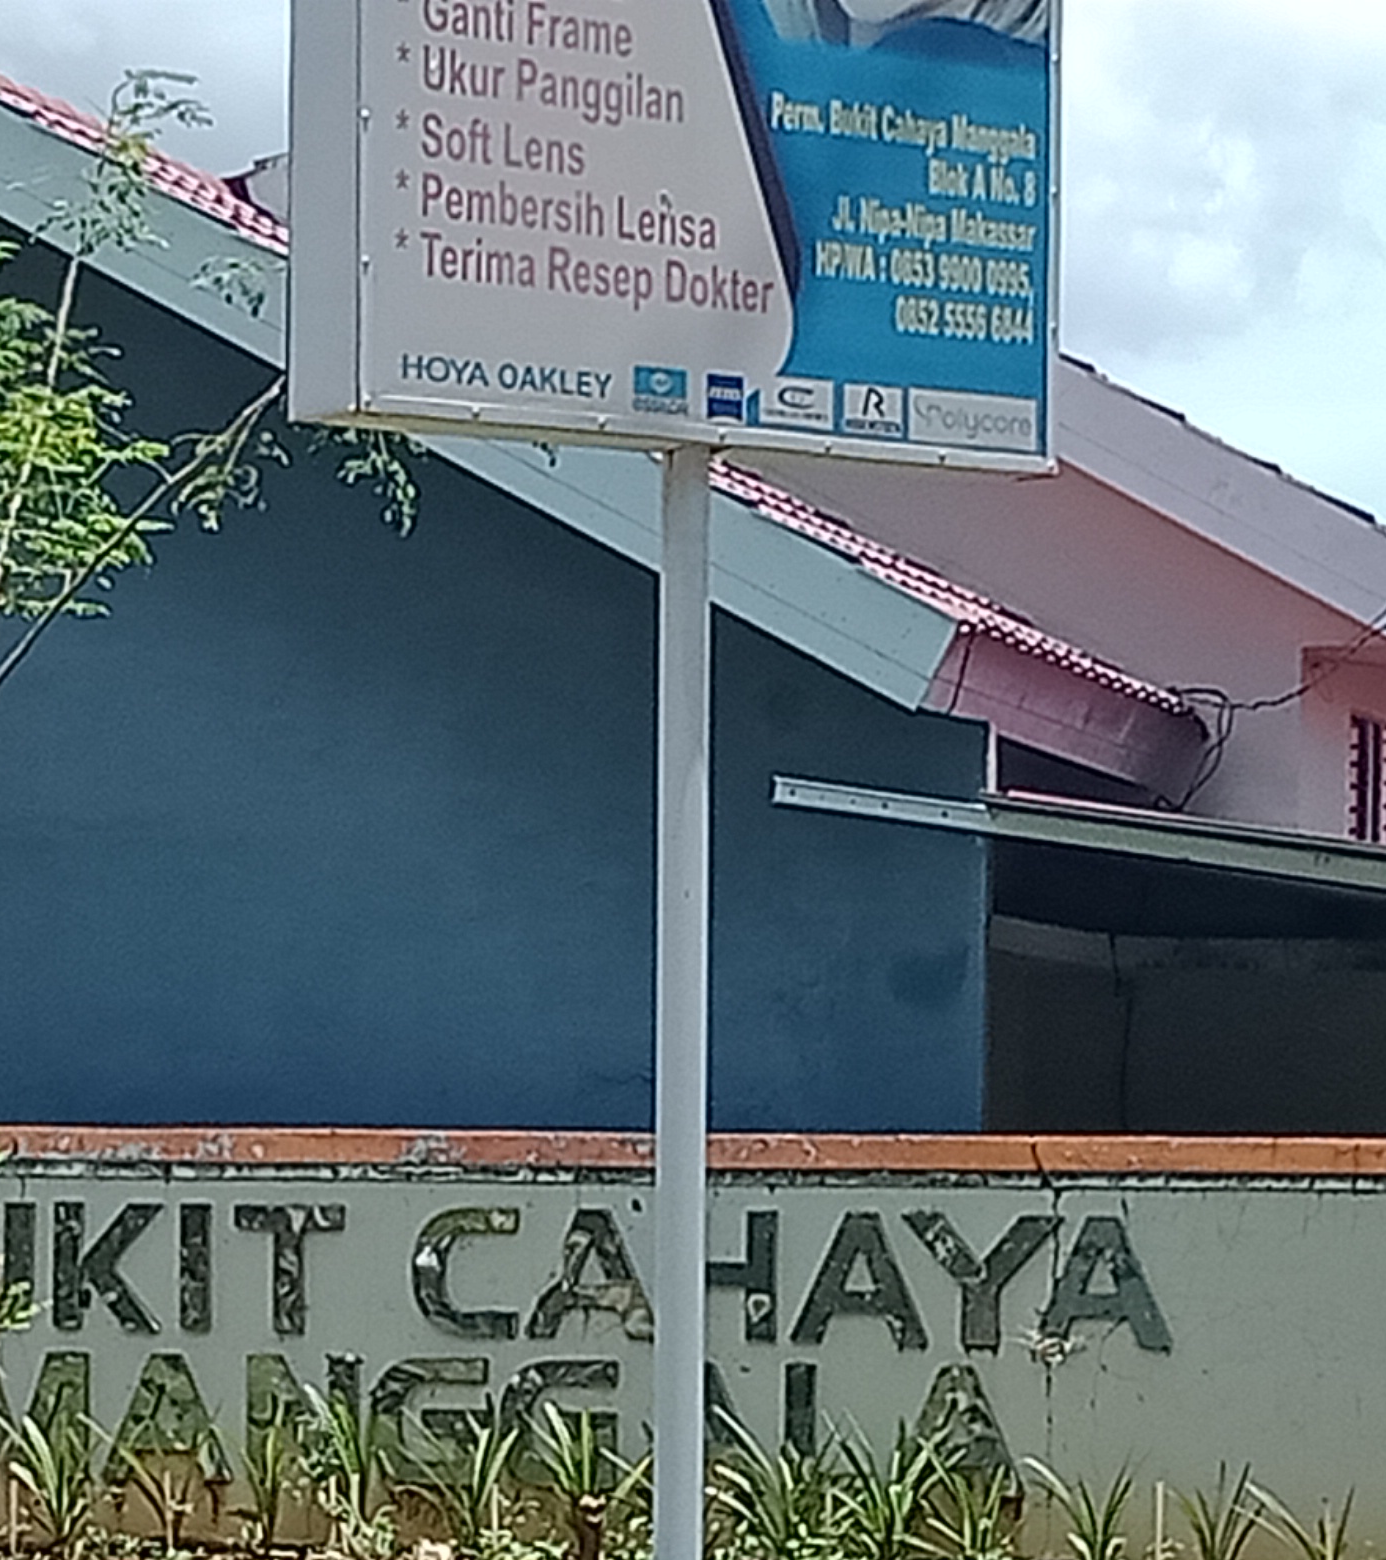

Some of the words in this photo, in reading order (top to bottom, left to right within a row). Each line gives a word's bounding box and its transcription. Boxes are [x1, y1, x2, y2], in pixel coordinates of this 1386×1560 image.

[422, 0, 513, 43] Ganti
[527, 2, 633, 57] Frame
[422, 44, 505, 98] Ukur
[516, 58, 684, 126] Panggilan
[421, 112, 492, 165] Soft
[504, 123, 585, 175] Lens
[771, 91, 824, 133] Perm.
[830, 100, 878, 141] Bukit
[882, 104, 947, 157] Cahaya
[951, 114, 1037, 165] Manggala
[421, 172, 604, 238] Pembersih
[617, 195, 716, 250] Lensa
[929, 158, 968, 197] Blok
[972, 163, 986, 200] A
[990, 165, 1020, 205] No.
[1024, 171, 1037, 207] 8
[860, 197, 947, 250] Nipa-Nipa
[951, 208, 1036, 251] Makassar
[420, 232, 535, 288] Terima
[548, 246, 652, 311] Resep
[664, 258, 774, 314] Dokter
[401, 353, 489, 388] HOYA
[497, 361, 612, 399] OAKLEY
